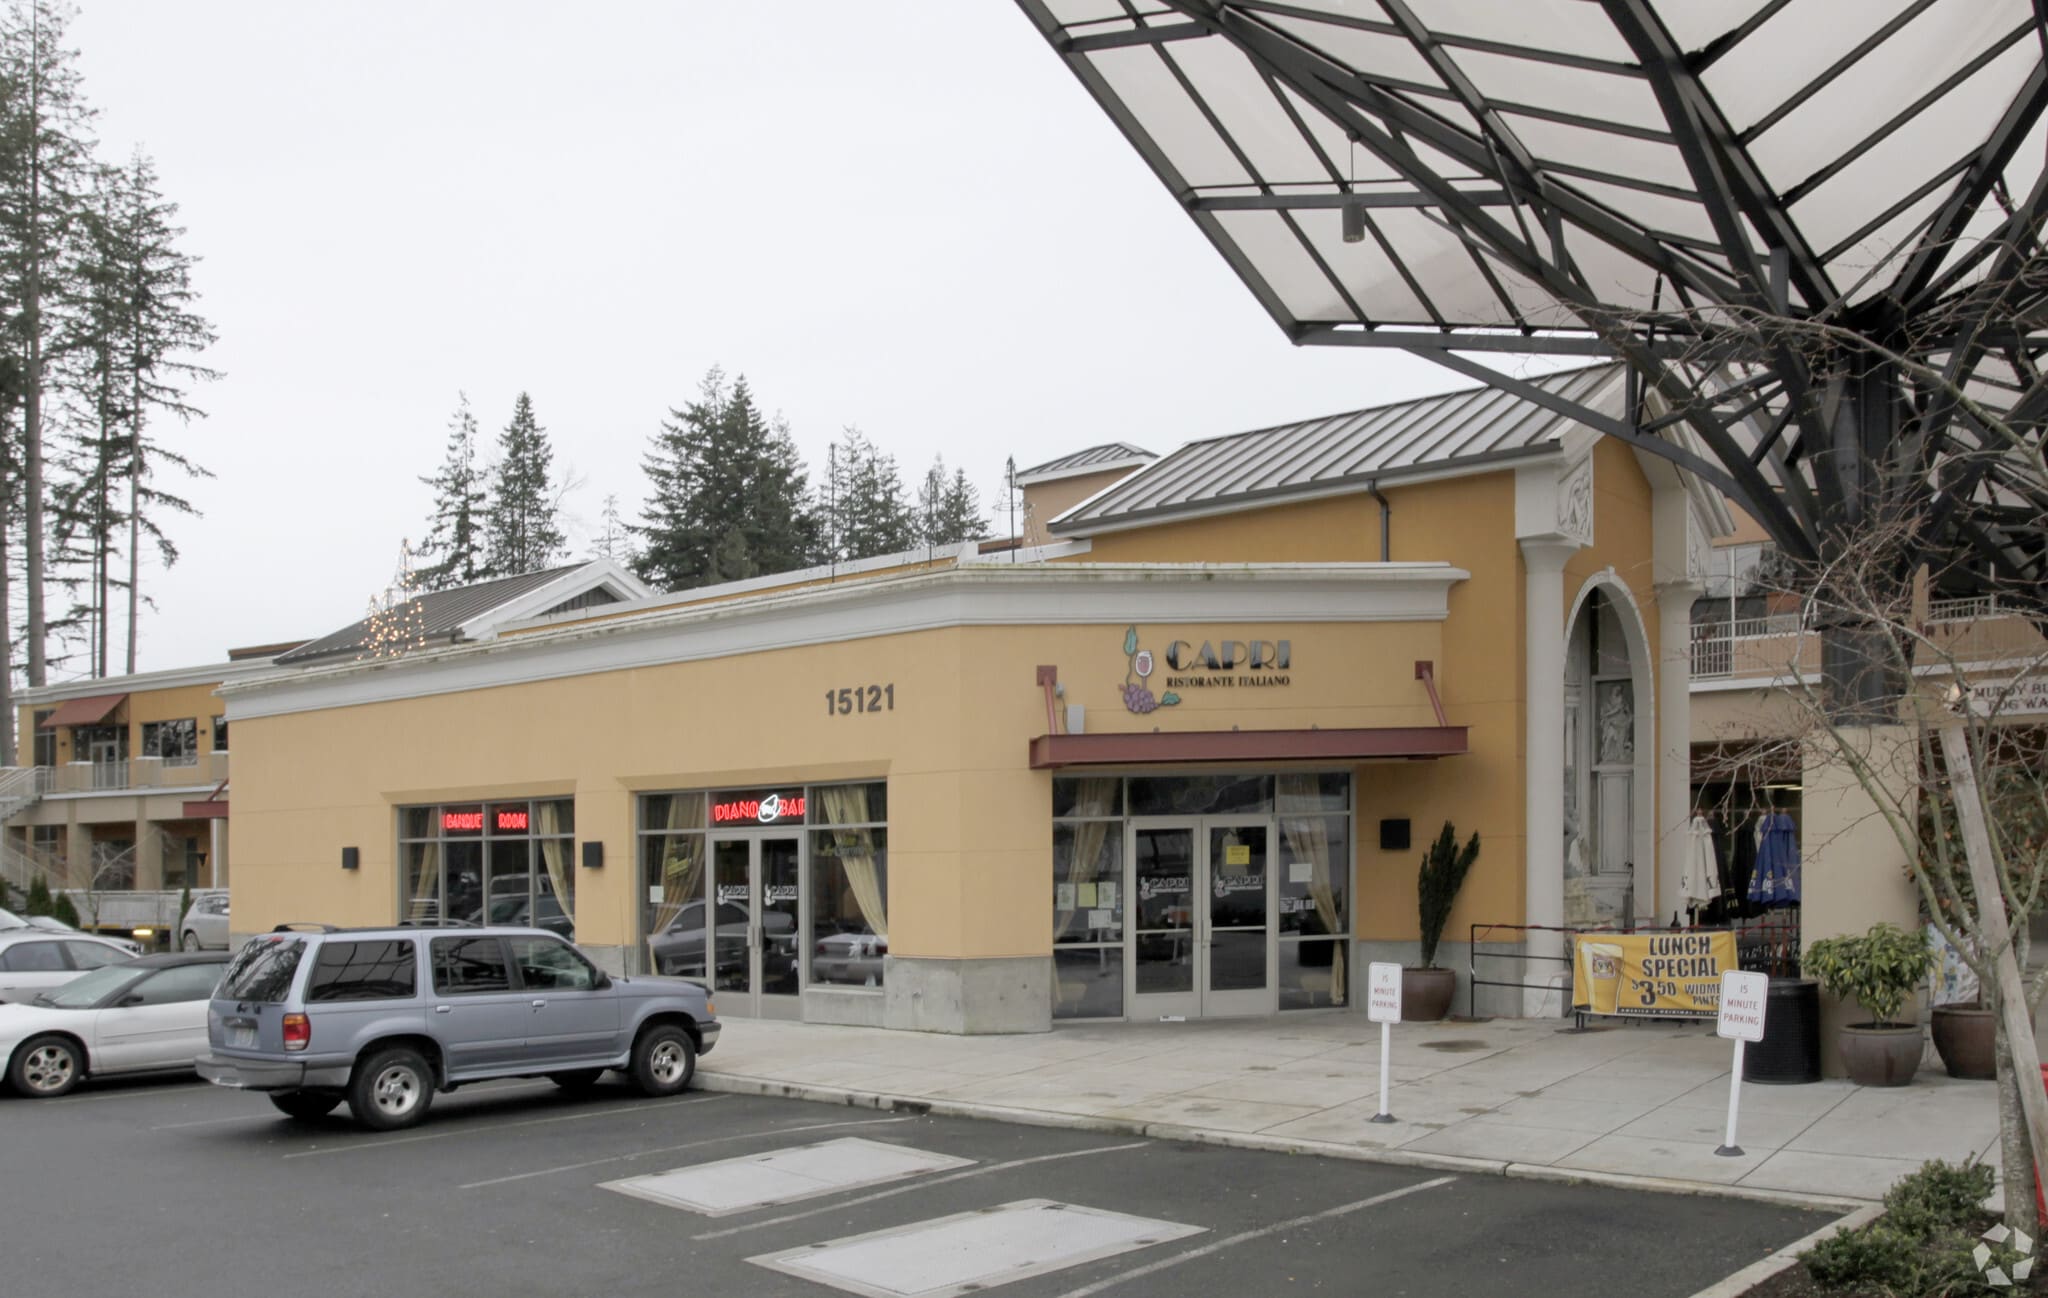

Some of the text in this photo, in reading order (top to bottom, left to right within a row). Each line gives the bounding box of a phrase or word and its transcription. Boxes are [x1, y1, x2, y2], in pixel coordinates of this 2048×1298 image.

[1166, 640, 1291, 671] CAPRI
[1166, 675, 1291, 688] RISTORANTE ITALIANO
[825, 683, 894, 716] 15121
[446, 813, 527, 829] BANQUE ROOM
[1649, 936, 1711, 956] LUNCH
[1642, 957, 1719, 978] SPECIAL
[1374, 987, 1397, 997] MINUTE
[1740, 984, 1749, 994] 15
[1372, 1000, 1399, 1010] PARKING
[1727, 998, 1759, 1010] MINUTE
[1723, 1013, 1760, 1026] PARKING
